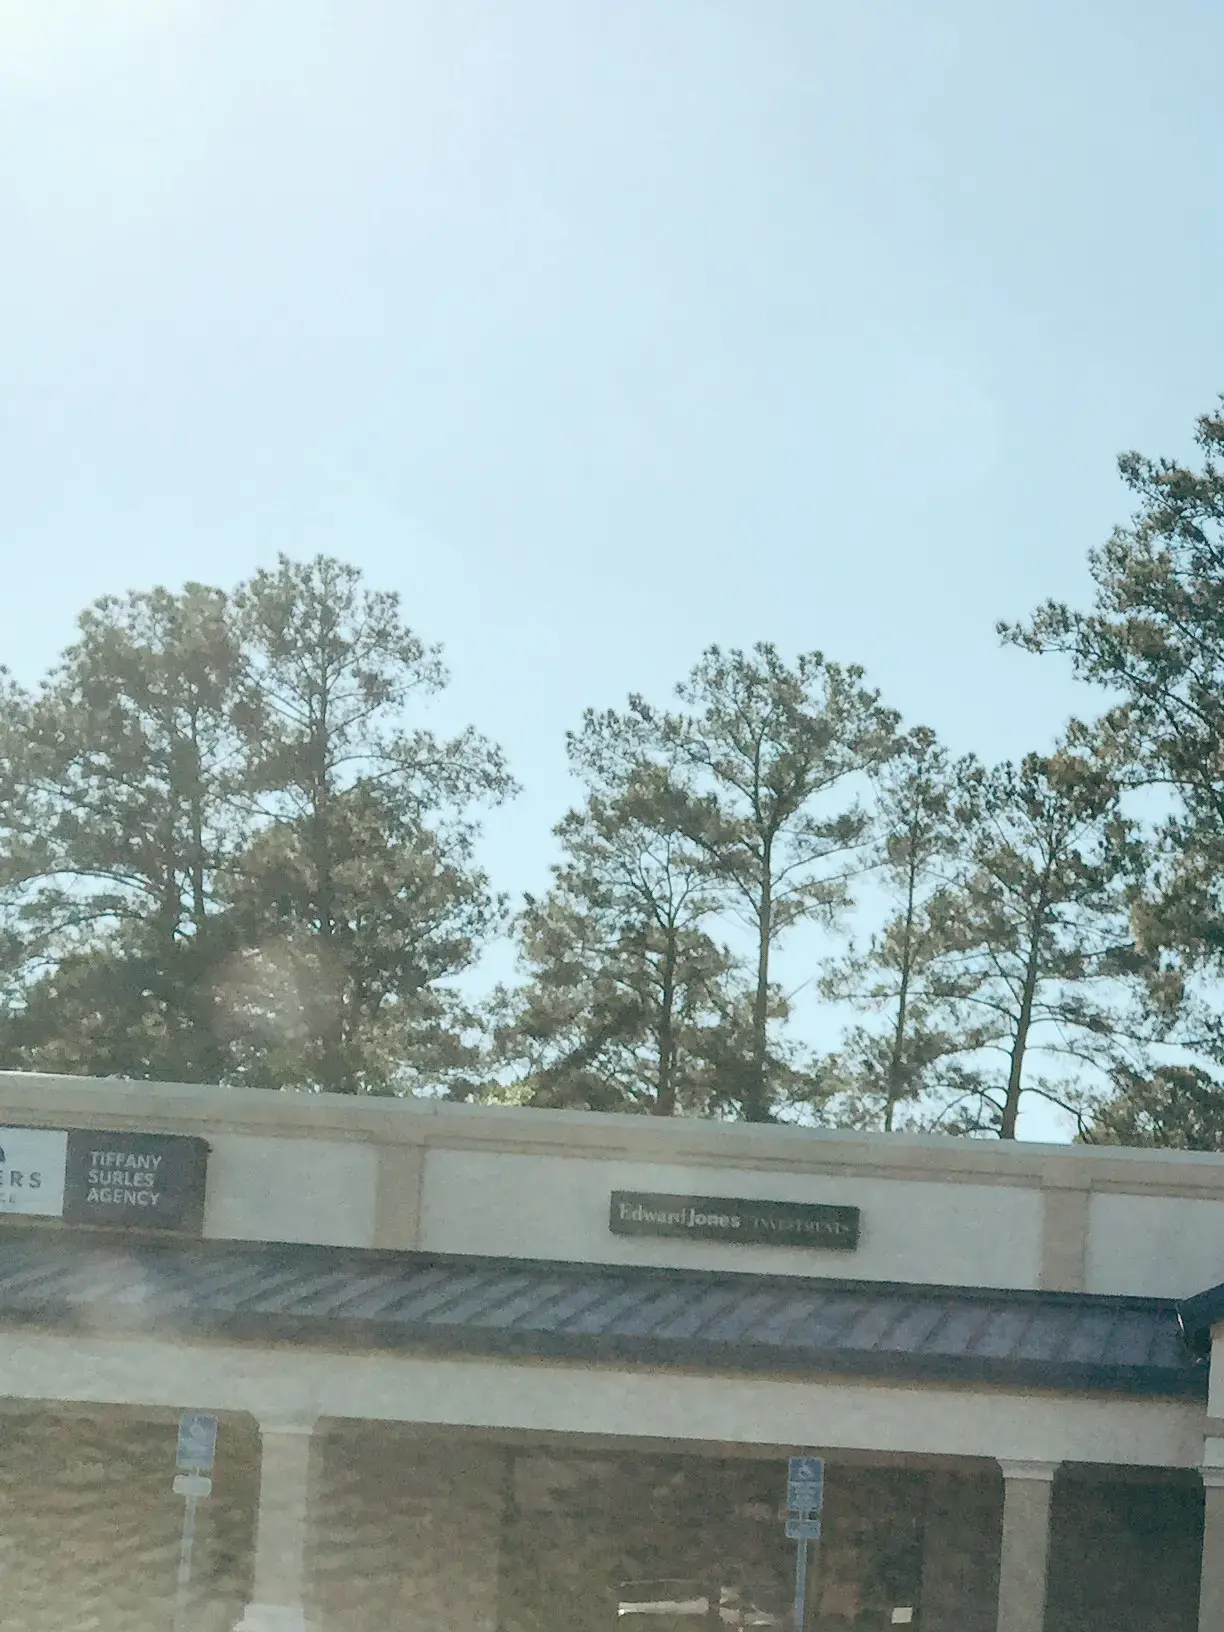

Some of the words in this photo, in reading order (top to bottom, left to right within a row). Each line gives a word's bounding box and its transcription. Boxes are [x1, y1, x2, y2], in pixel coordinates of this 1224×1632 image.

[91, 1151, 162, 1170] TIFFANY
[88, 1168, 155, 1187] SURLES
[87, 1187, 160, 1206] AGENCY
